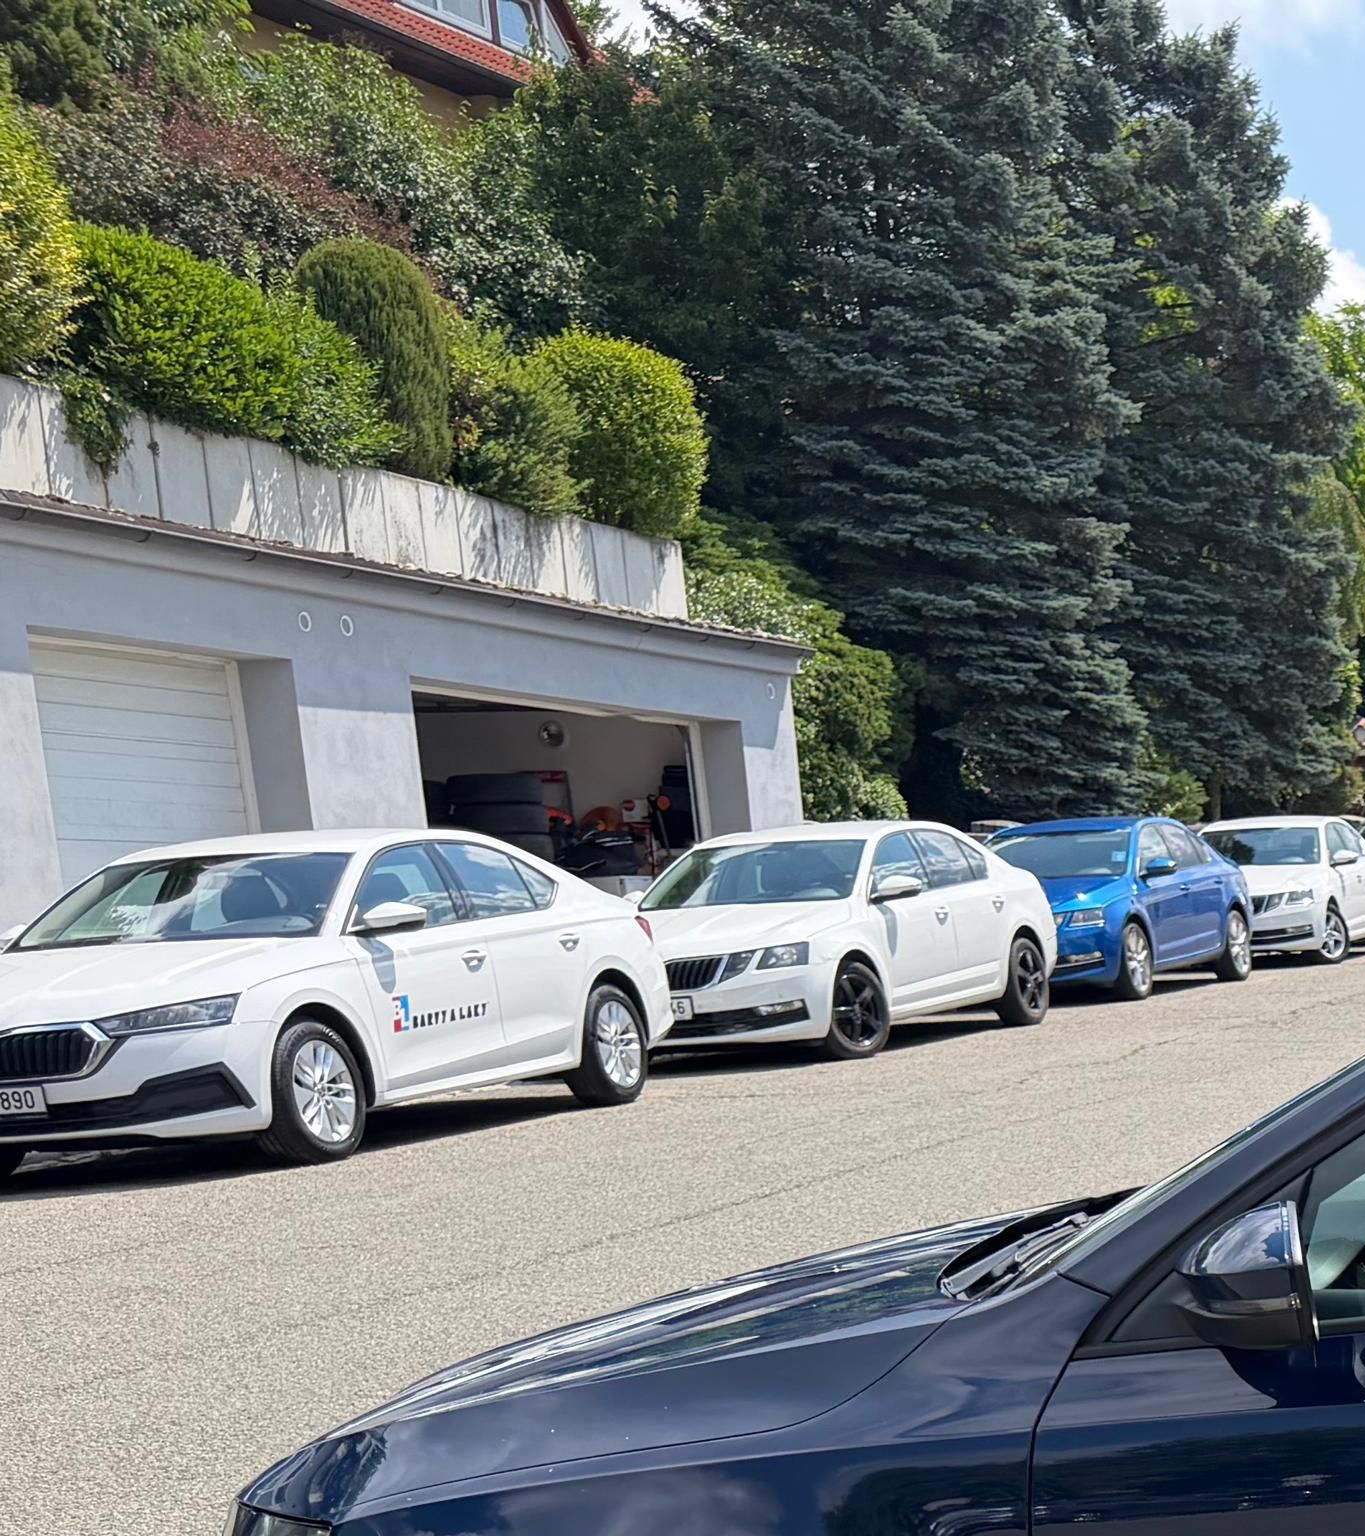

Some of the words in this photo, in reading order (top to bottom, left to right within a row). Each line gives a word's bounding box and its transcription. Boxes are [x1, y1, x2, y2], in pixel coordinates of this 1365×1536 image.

[413, 1010, 447, 1029] BARVY
[450, 1008, 456, 1022] A
[459, 1002, 487, 1020] LAKY
[0, 1090, 35, 1110] 890
